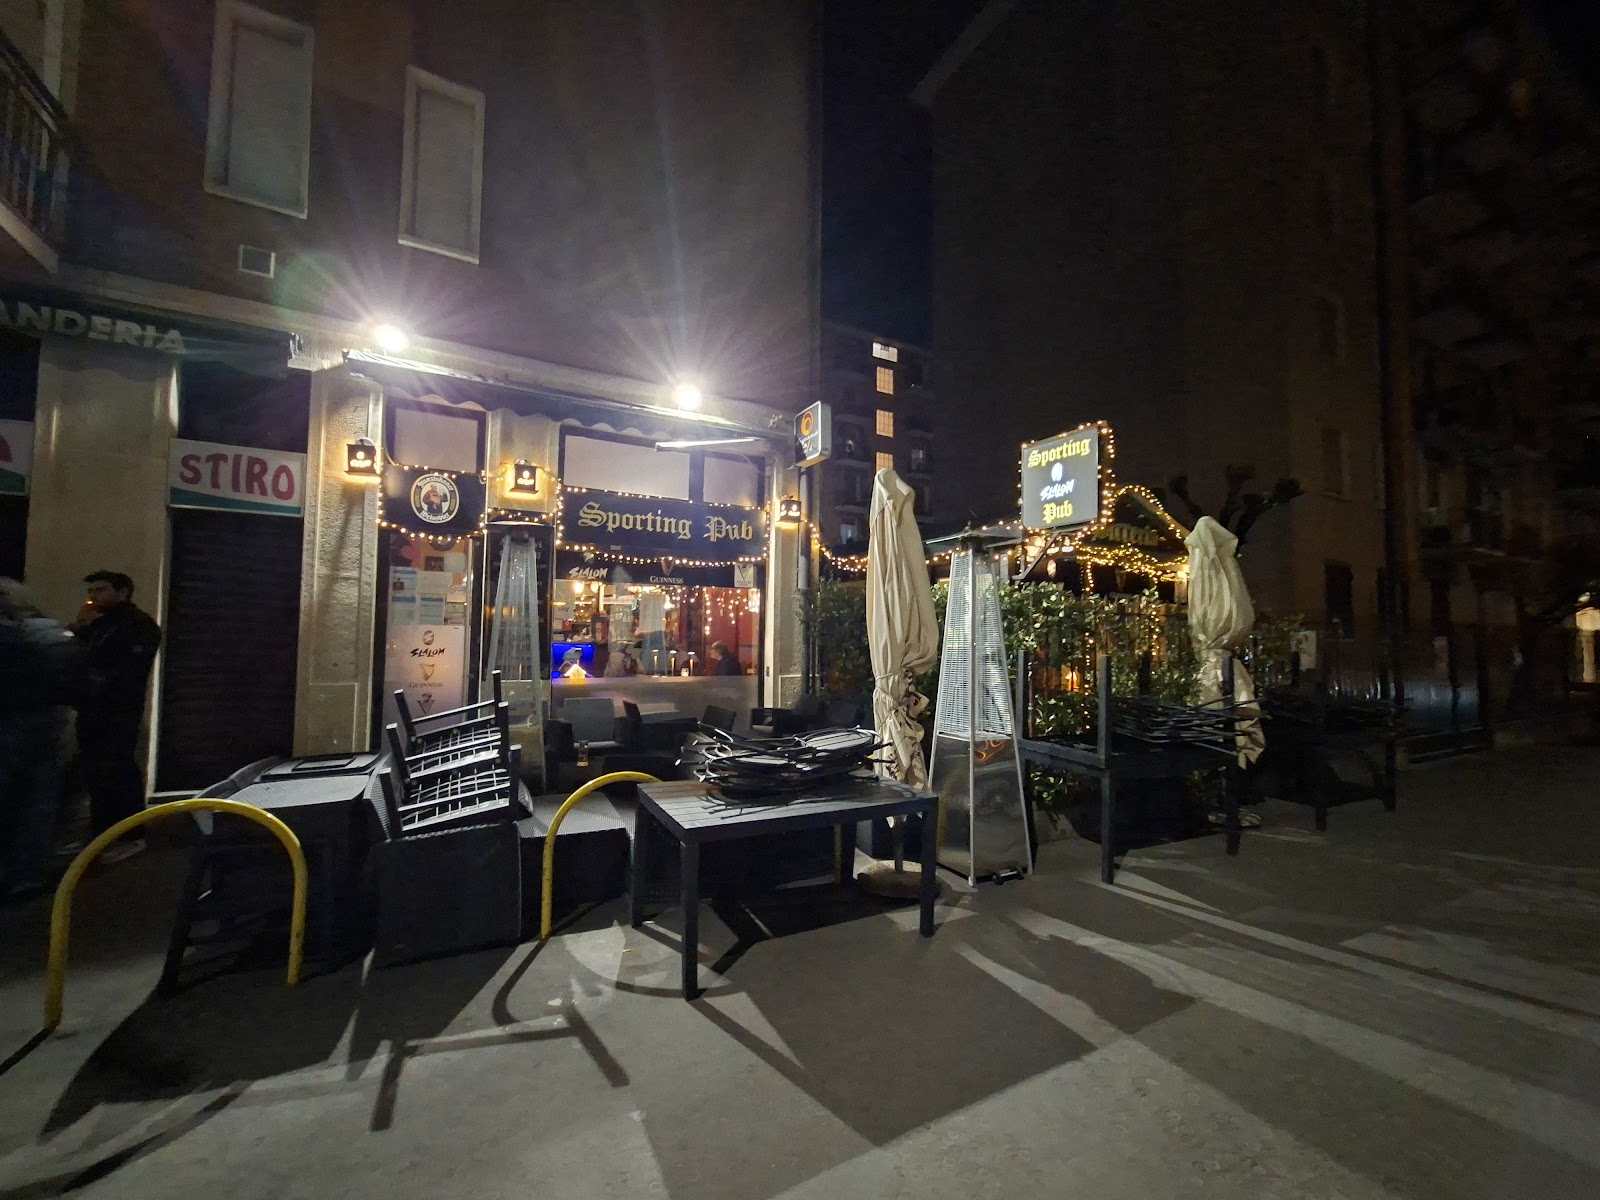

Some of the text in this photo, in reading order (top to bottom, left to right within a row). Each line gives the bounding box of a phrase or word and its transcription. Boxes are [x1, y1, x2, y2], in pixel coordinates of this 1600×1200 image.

[1028, 440, 1091, 466] Sporting
[180, 453, 295, 501] STIRO
[578, 502, 753, 542] Sporting Pub
[1043, 500, 1073, 523] Pub
[568, 566, 608, 580] SLALOM
[649, 575, 684, 585] GUINNESS
[410, 646, 446, 658] SLALOM
